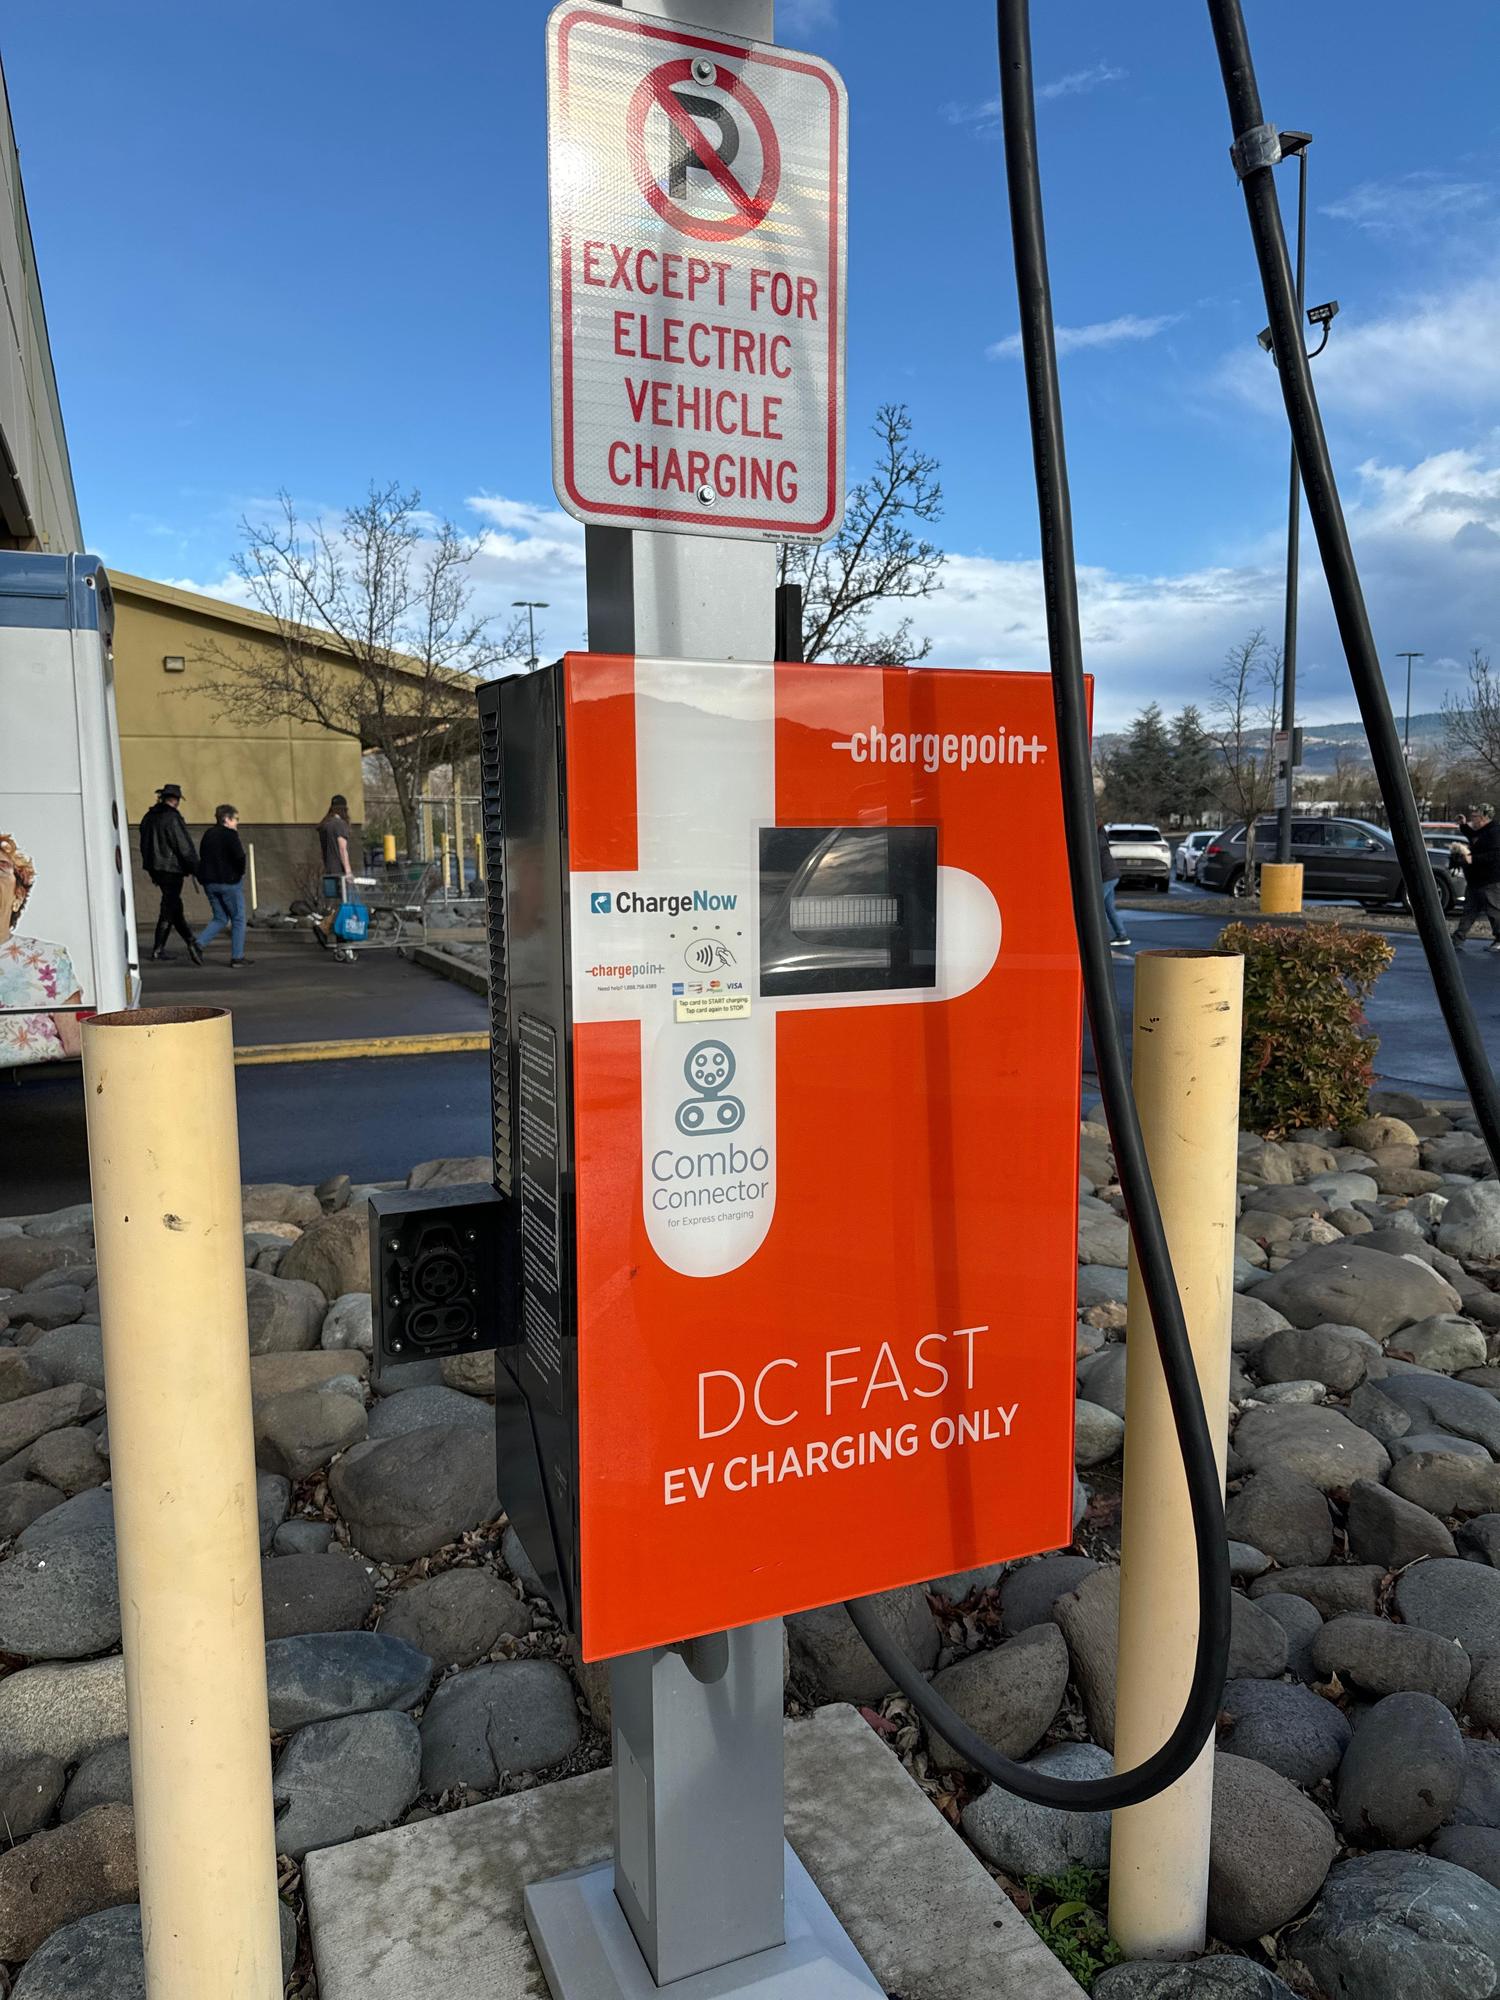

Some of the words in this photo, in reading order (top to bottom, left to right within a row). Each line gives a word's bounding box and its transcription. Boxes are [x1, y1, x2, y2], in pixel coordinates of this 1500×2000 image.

[583, 241, 732, 306] EXCEPT
[750, 268, 819, 321] FOR
[613, 311, 792, 379] ELECTRIC
[625, 378, 784, 441] VEHICLE
[607, 440, 799, 505] CHARGING
[616, 890, 738, 917] ChargeNow
[727, 982, 743, 990] VISA
[652, 1143, 769, 1181] Combo
[652, 1180, 769, 1210] Connector
[668, 1218, 680, 1228] for
[682, 1213, 716, 1226] Express
[717, 1210, 755, 1222] charging
[698, 1358, 799, 1440] DC
[825, 1325, 989, 1416] FAST
[664, 1462, 715, 1506] EV
[723, 1423, 919, 1492] CHARGING
[929, 1402, 1020, 1451] ONLY
